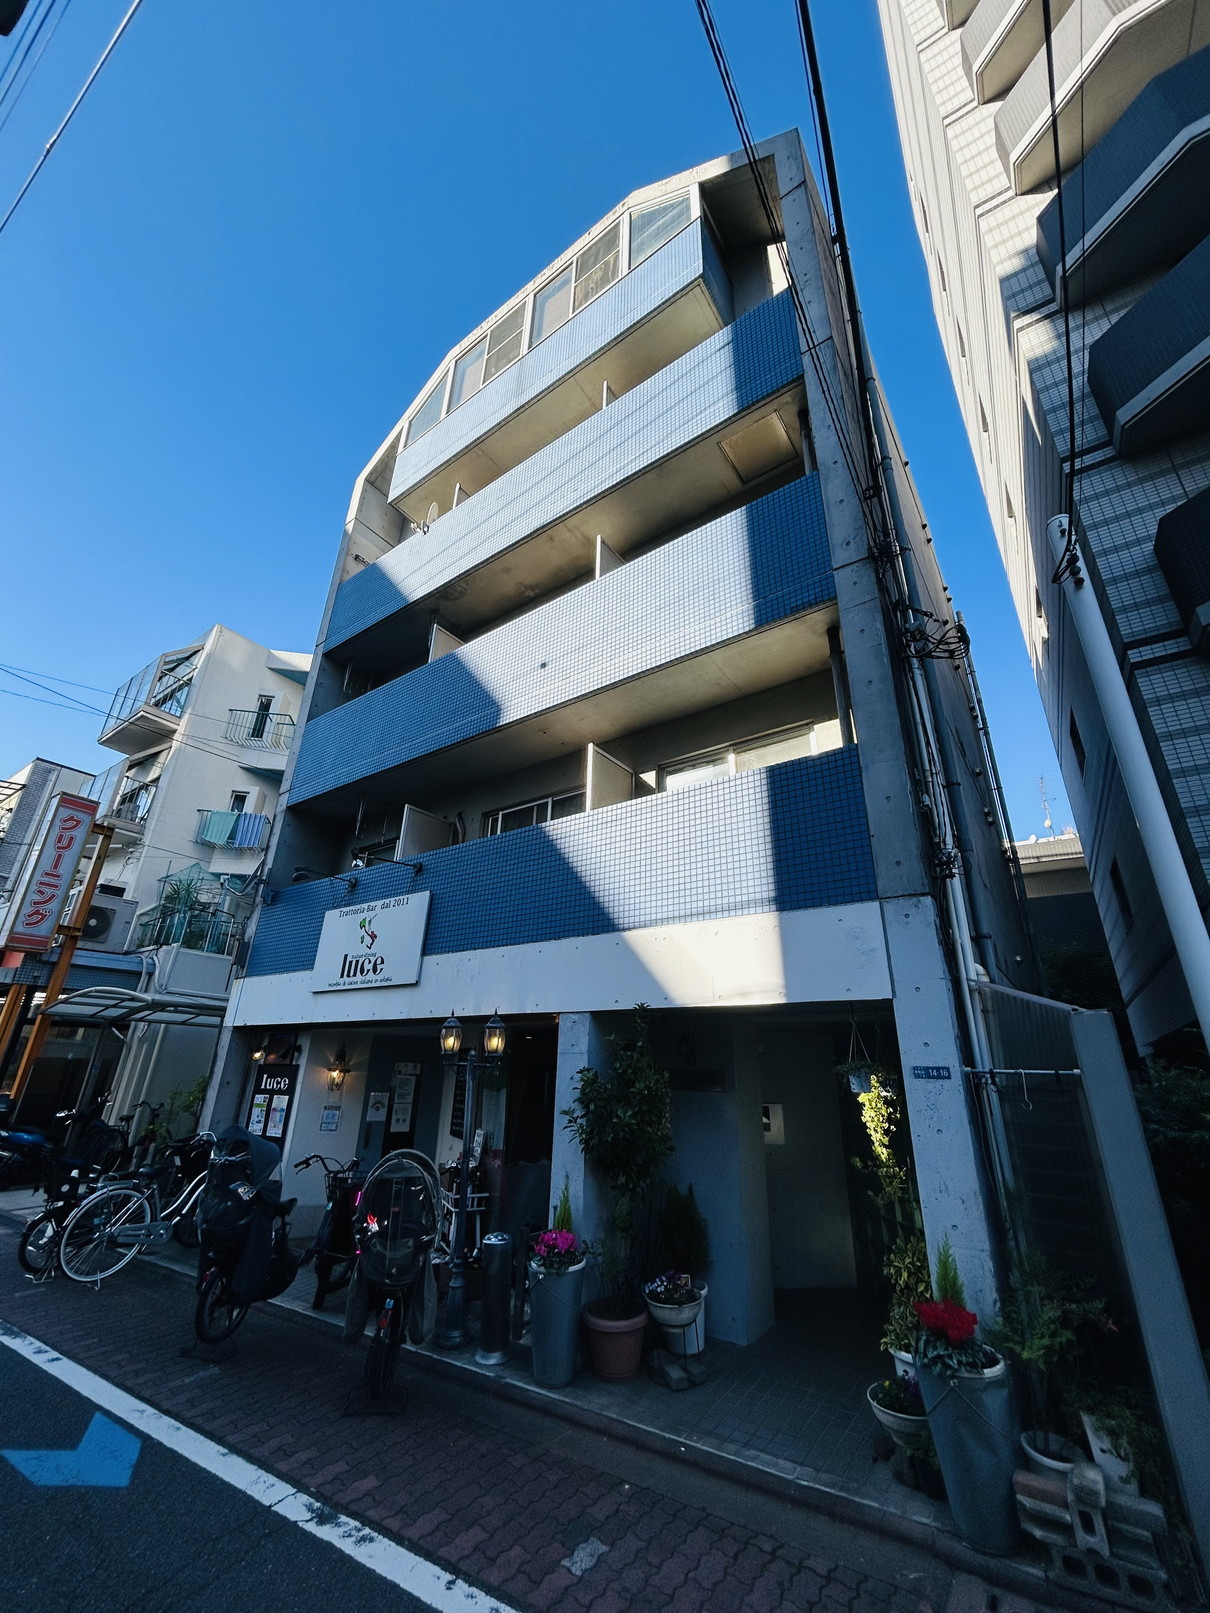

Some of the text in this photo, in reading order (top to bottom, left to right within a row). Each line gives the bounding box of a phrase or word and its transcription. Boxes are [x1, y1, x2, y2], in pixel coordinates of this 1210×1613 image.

[23, 813, 84, 928] クリーニング
[339, 897, 409, 918] Trattoria-Bar dal 2011
[340, 954, 385, 979] luce
[260, 1074, 289, 1090] luce
[929, 1069, 949, 1077] 14-16
